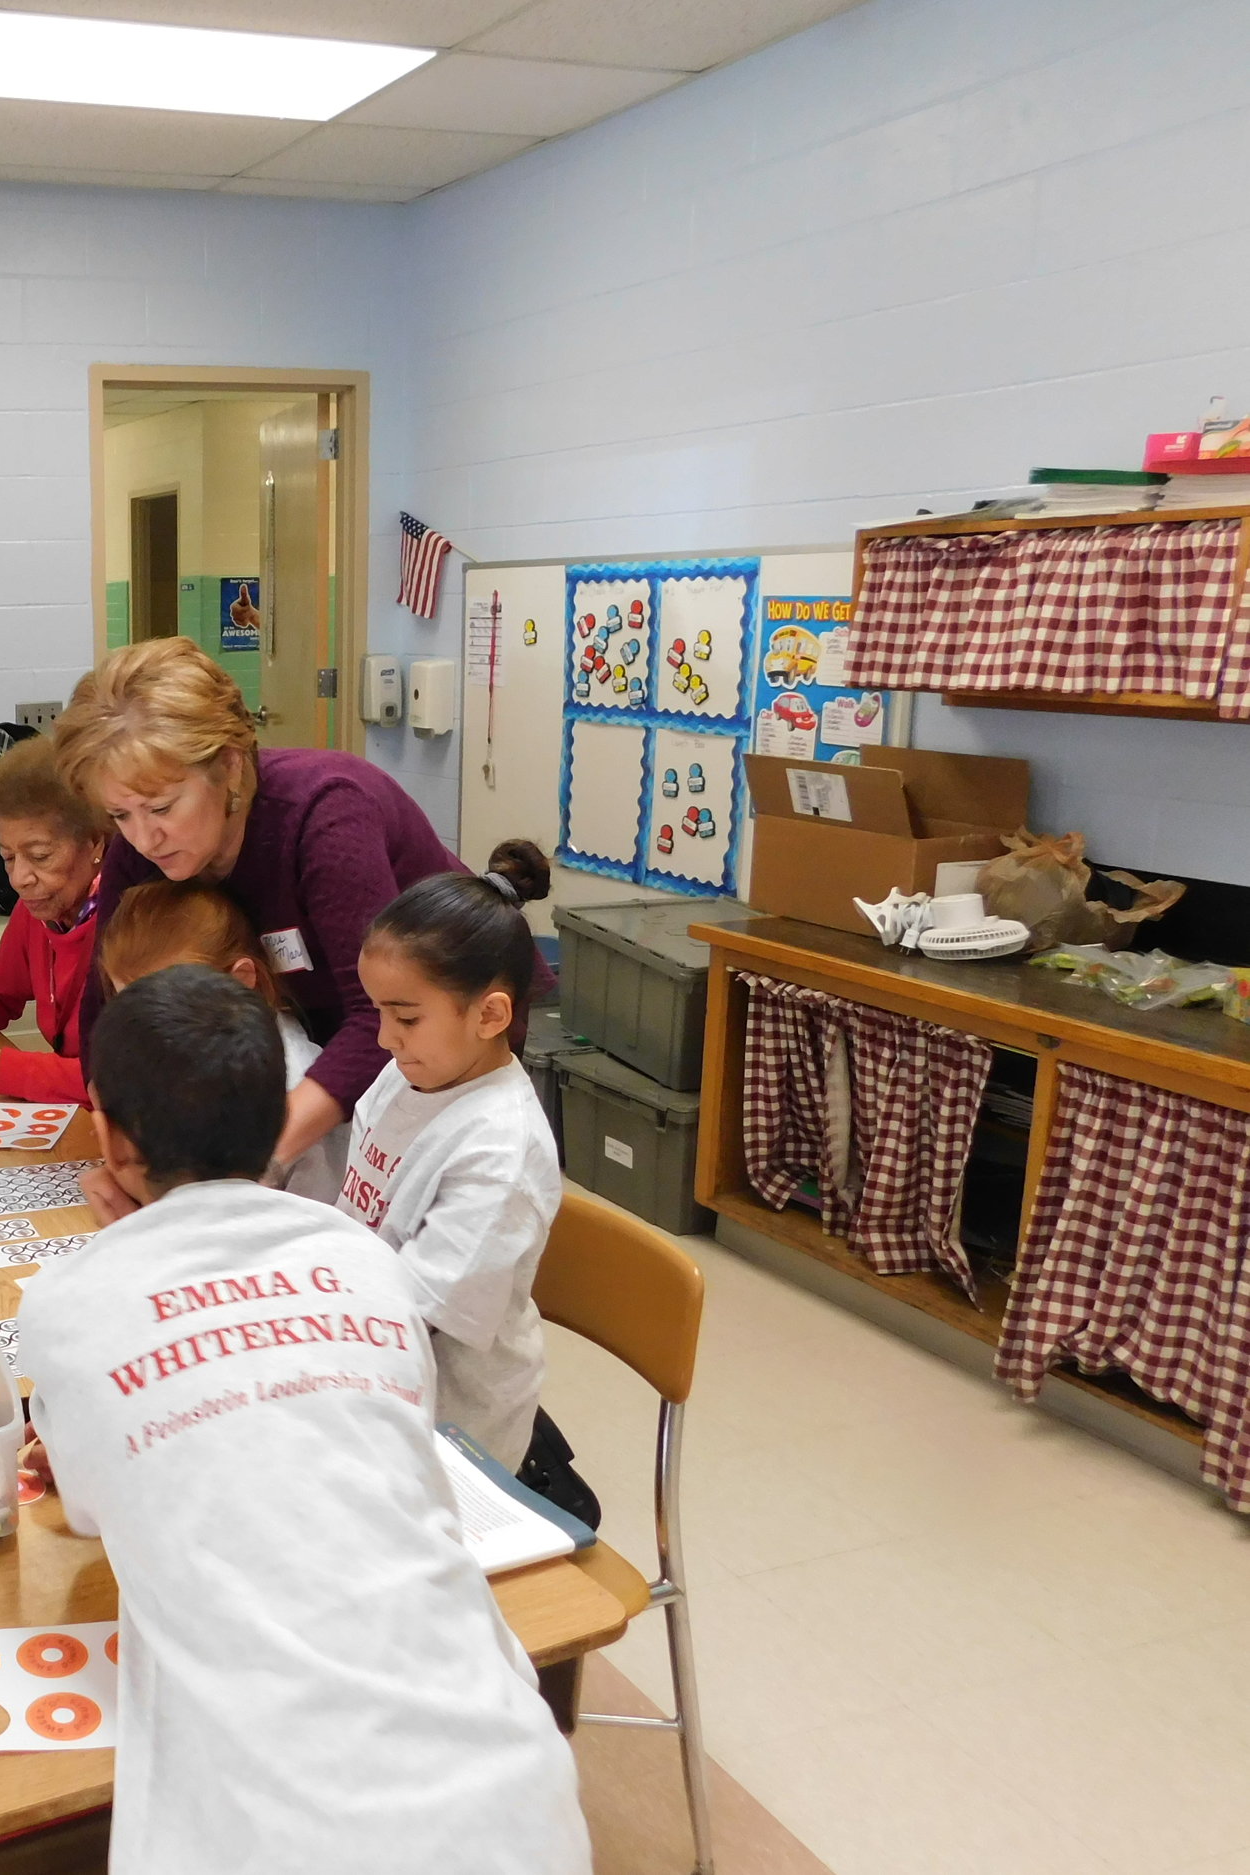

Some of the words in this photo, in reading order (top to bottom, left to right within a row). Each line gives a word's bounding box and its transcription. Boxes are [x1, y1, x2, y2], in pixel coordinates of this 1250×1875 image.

[767, 601, 793, 620] HOW
[813, 602, 829, 620] WE
[832, 601, 852, 621] GET
[146, 1270, 301, 1323] EMMA
[311, 1265, 354, 1295] G.
[108, 1313, 410, 1397] WHITEKNACT
